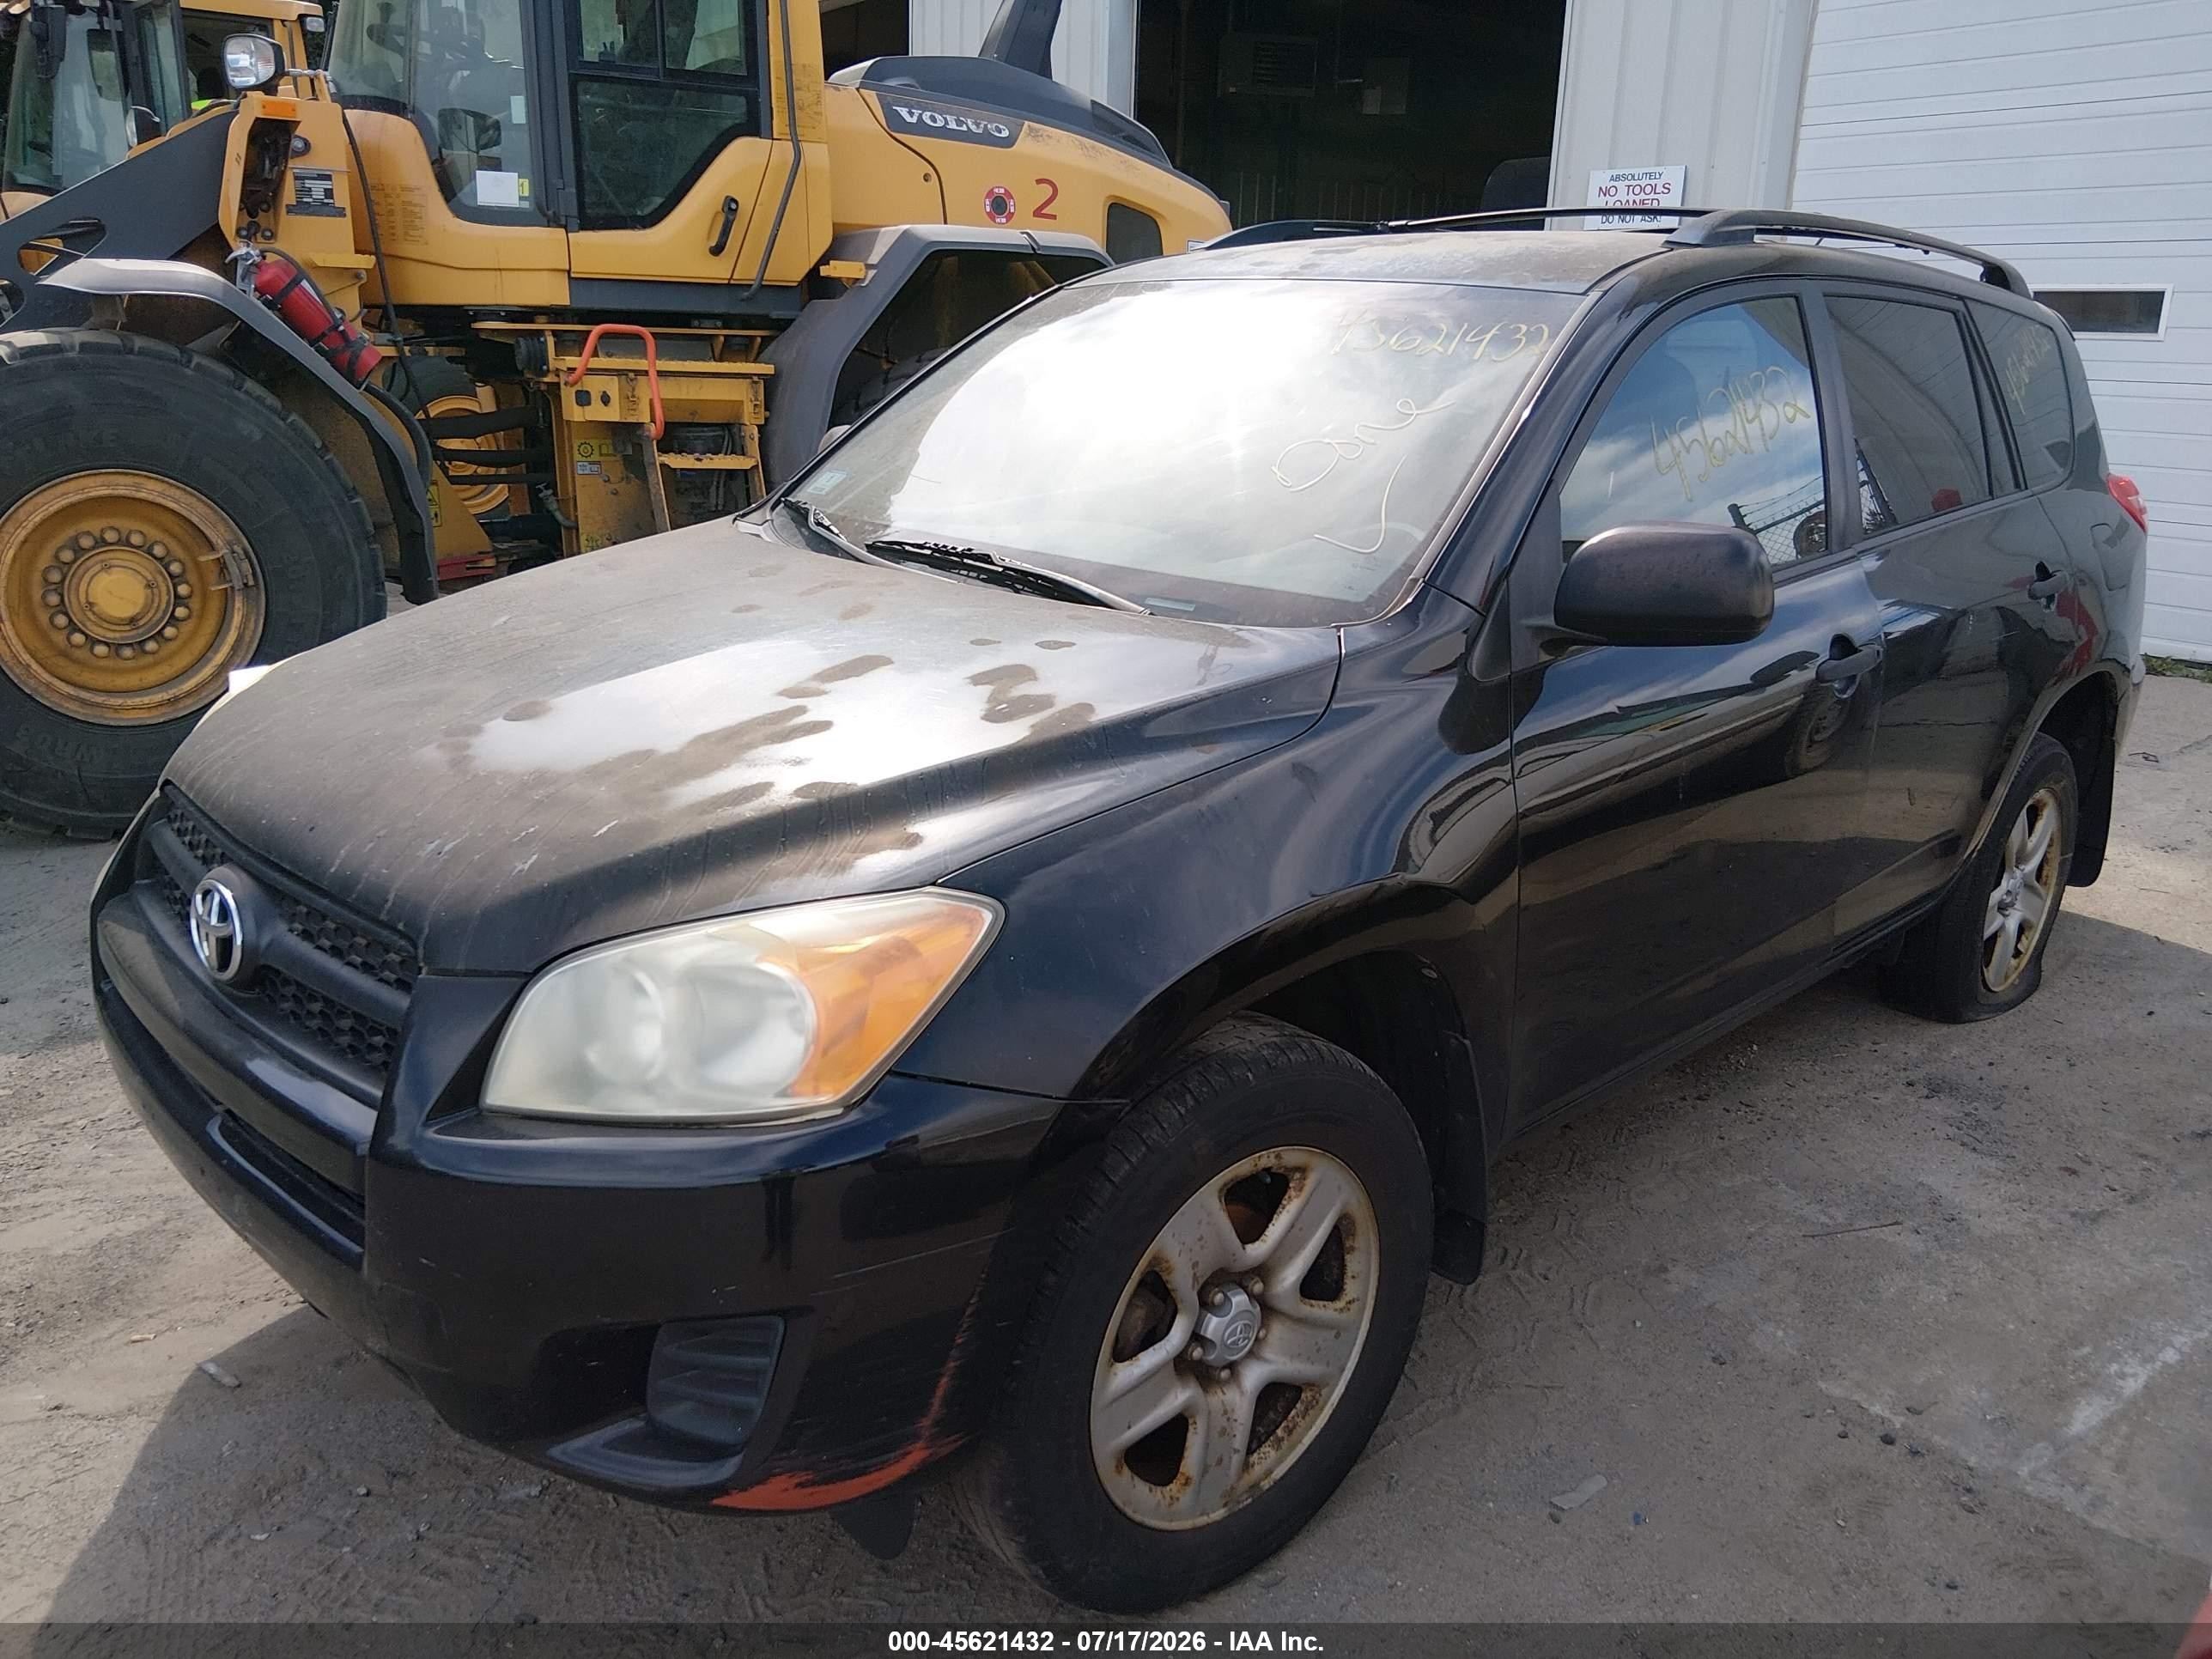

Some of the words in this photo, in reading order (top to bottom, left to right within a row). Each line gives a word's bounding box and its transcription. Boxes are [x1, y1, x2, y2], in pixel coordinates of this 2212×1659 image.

[892, 106, 1010, 138] VOLVO
[1609, 171, 1664, 183] ABSOLUTELY
[1598, 185, 1618, 198] NO
[1625, 182, 1672, 197] TOOLS
[1032, 178, 1059, 221] 2
[1601, 215, 1614, 224] DO
[1618, 215, 1635, 223] NOT
[1641, 215, 1662, 223] ASK!
